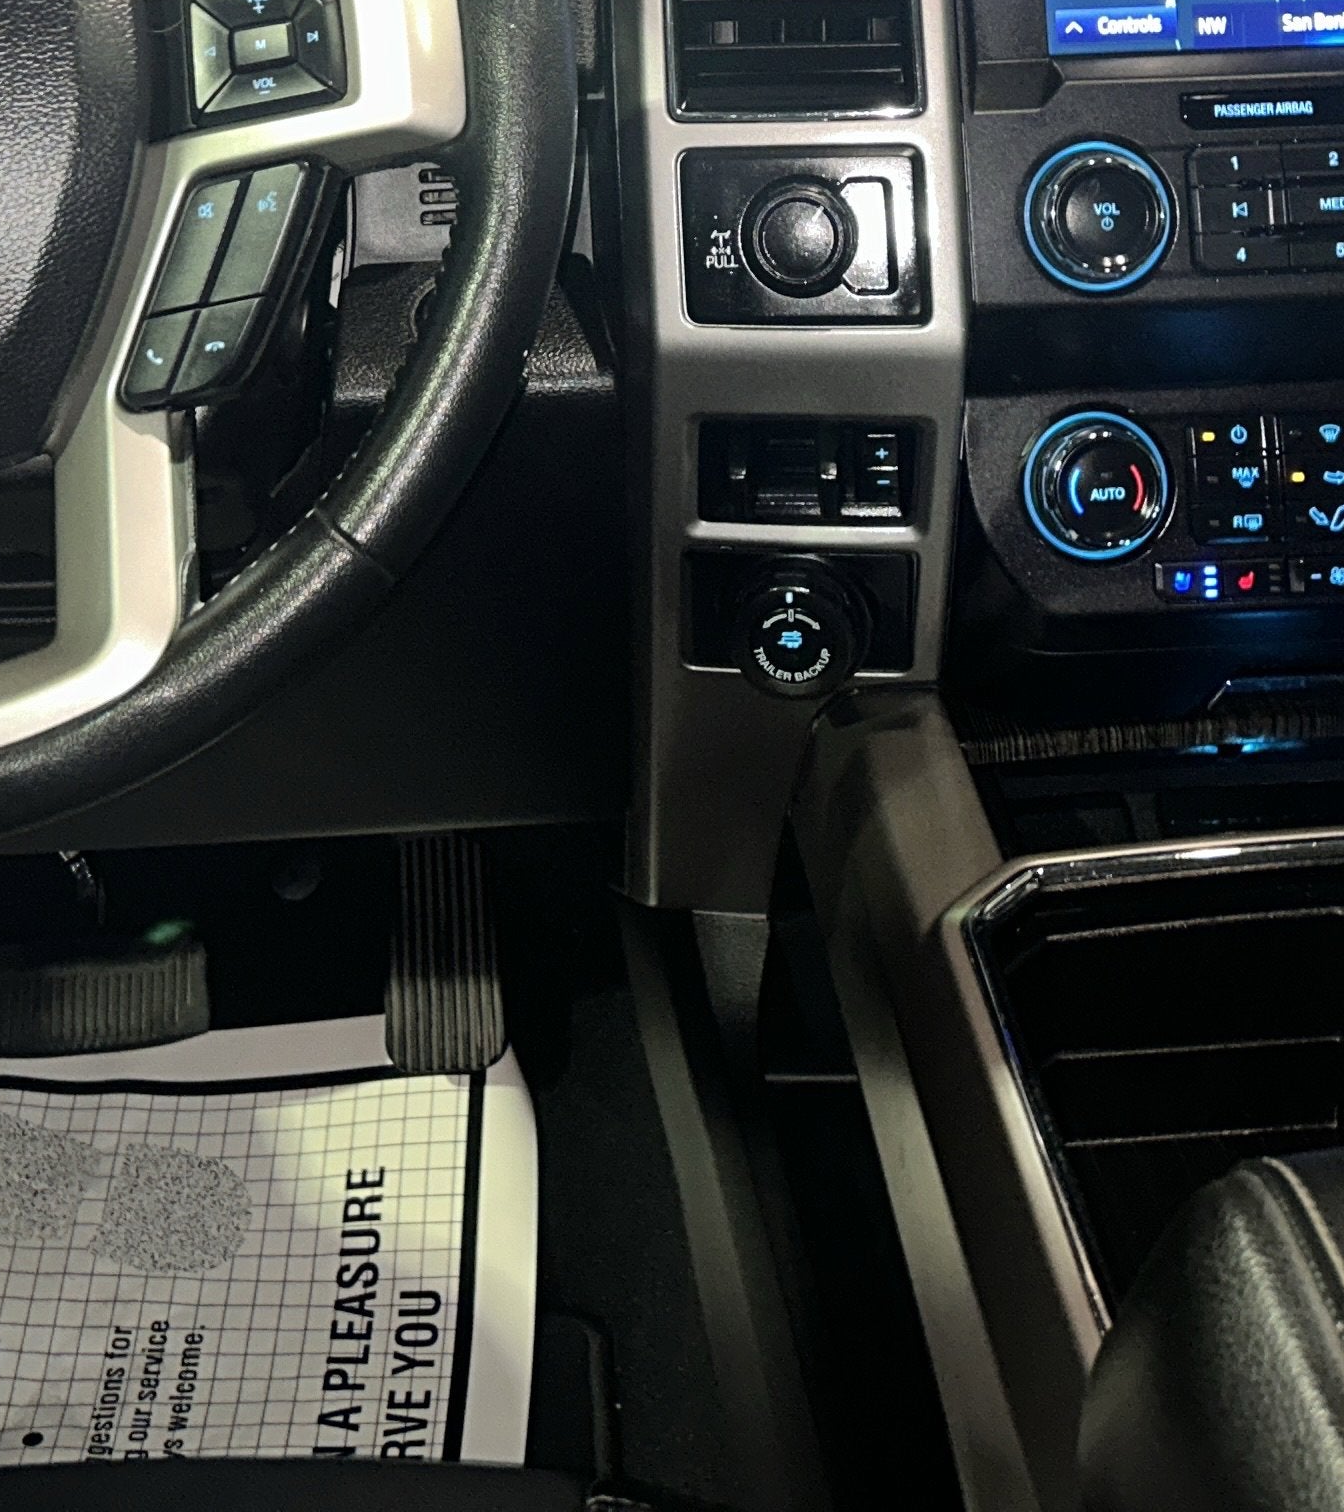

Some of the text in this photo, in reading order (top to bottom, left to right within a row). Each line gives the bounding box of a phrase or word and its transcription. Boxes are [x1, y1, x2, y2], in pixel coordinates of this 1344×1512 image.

[1097, 14, 1163, 35] Controls
[1198, 16, 1227, 35] NW
[1282, 13, 1312, 32] San
[256, 39, 266, 49] M
[252, 77, 277, 89] VOL
[1214, 102, 1273, 118] PASSENGER
[1229, 156, 1239, 170] 1
[1329, 151, 1339, 167] 2
[1093, 202, 1121, 216] VOL
[706, 255, 738, 269] PULL
[1236, 247, 1247, 262] 4
[1232, 466, 1259, 480] MAX
[1090, 486, 1126, 502] AUTO
[1233, 514, 1243, 529] R
[754, 646, 831, 682] TRAILER BACKUP
[322, 1166, 385, 1391] PLEASURE
[391, 1290, 442, 1375] YOU
[138, 1320, 170, 1402] service
[168, 1325, 206, 1432] welcome.
[86, 1325, 133, 1462] gestions for
[128, 1407, 153, 1442] our
[317, 1405, 362, 1432] A
